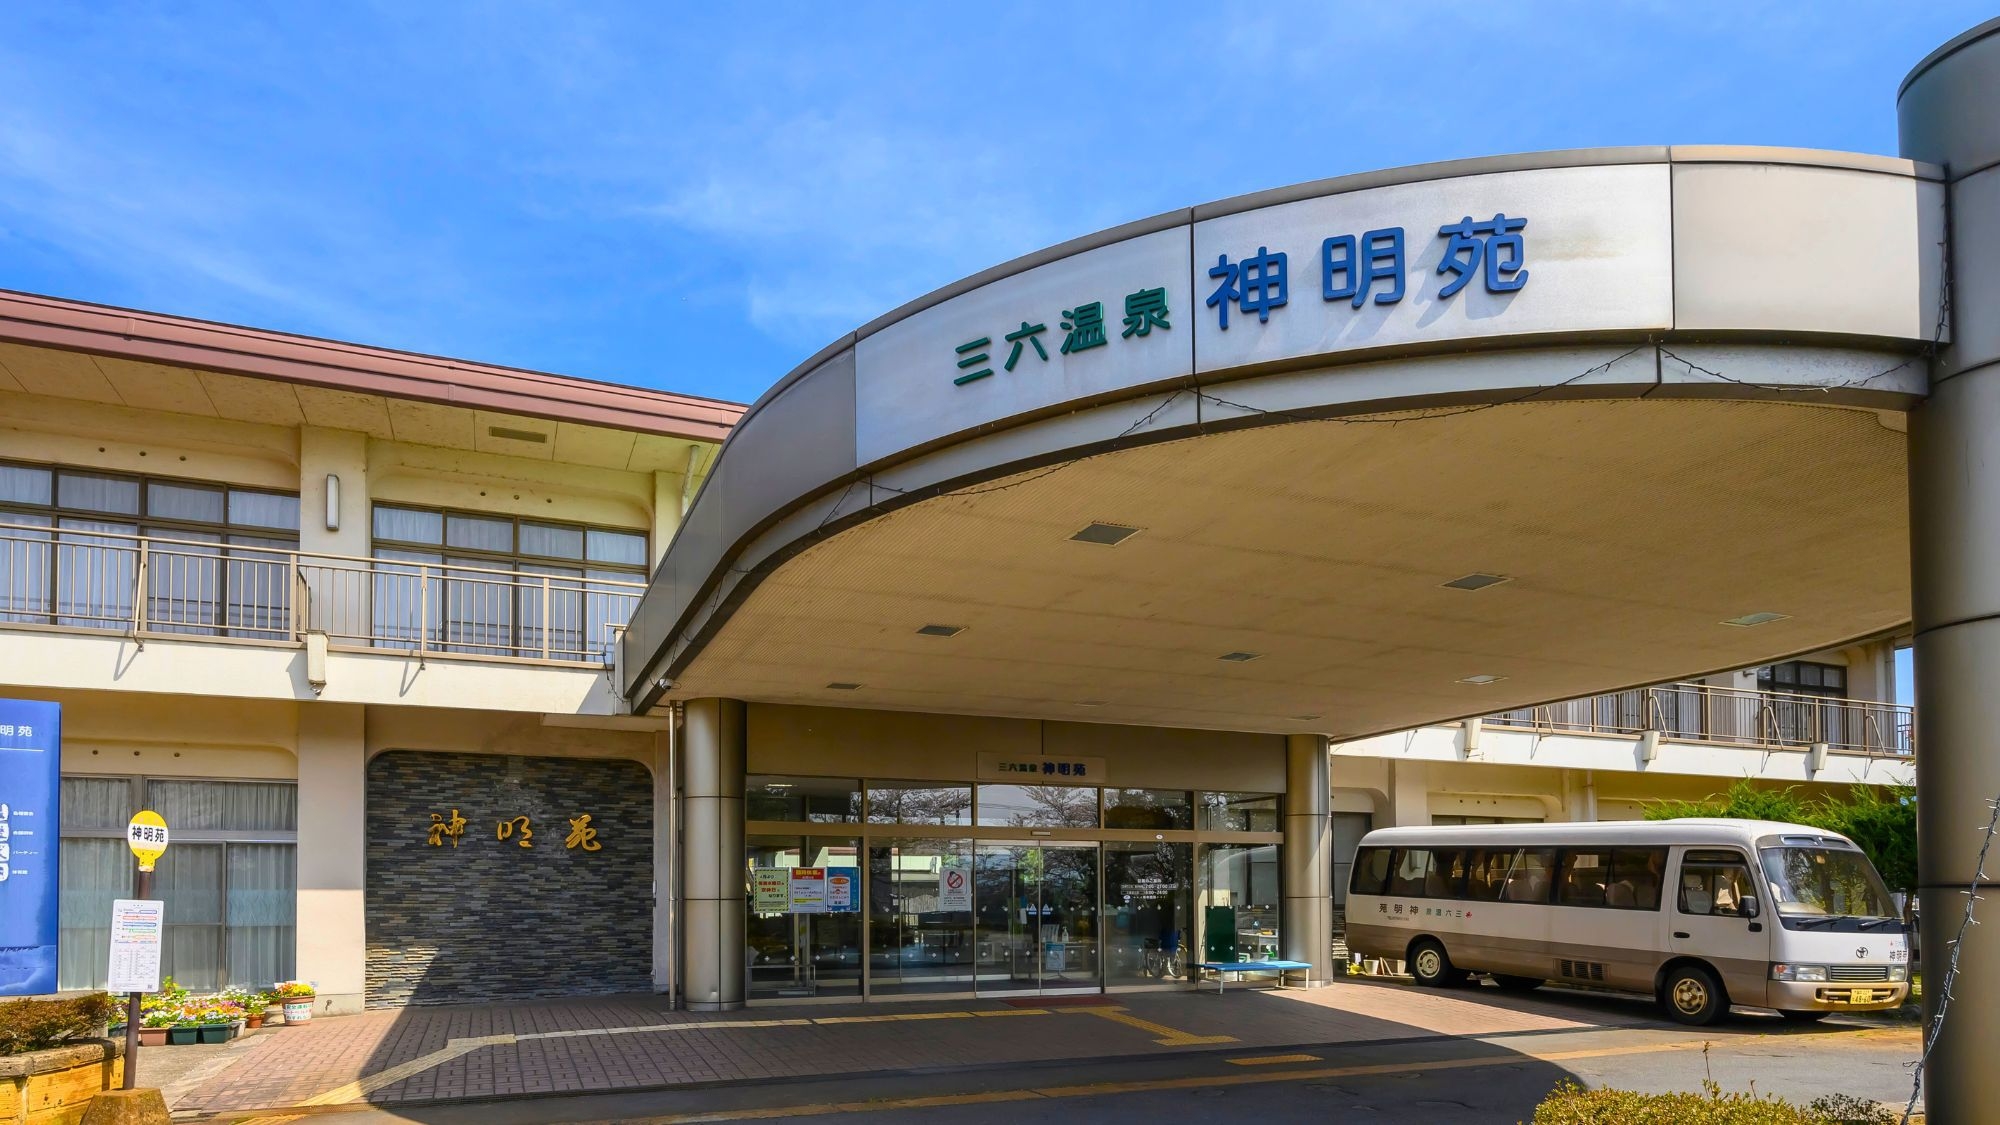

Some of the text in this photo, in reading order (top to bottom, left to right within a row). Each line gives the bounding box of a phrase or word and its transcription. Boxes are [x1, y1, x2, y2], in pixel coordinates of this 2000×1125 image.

[954, 213, 1529, 386] 三六温泉 神明苑
[1043, 762, 1086, 776] 神明苑
[132, 825, 165, 842] 神明苑
[428, 809, 602, 851] 神明苑
